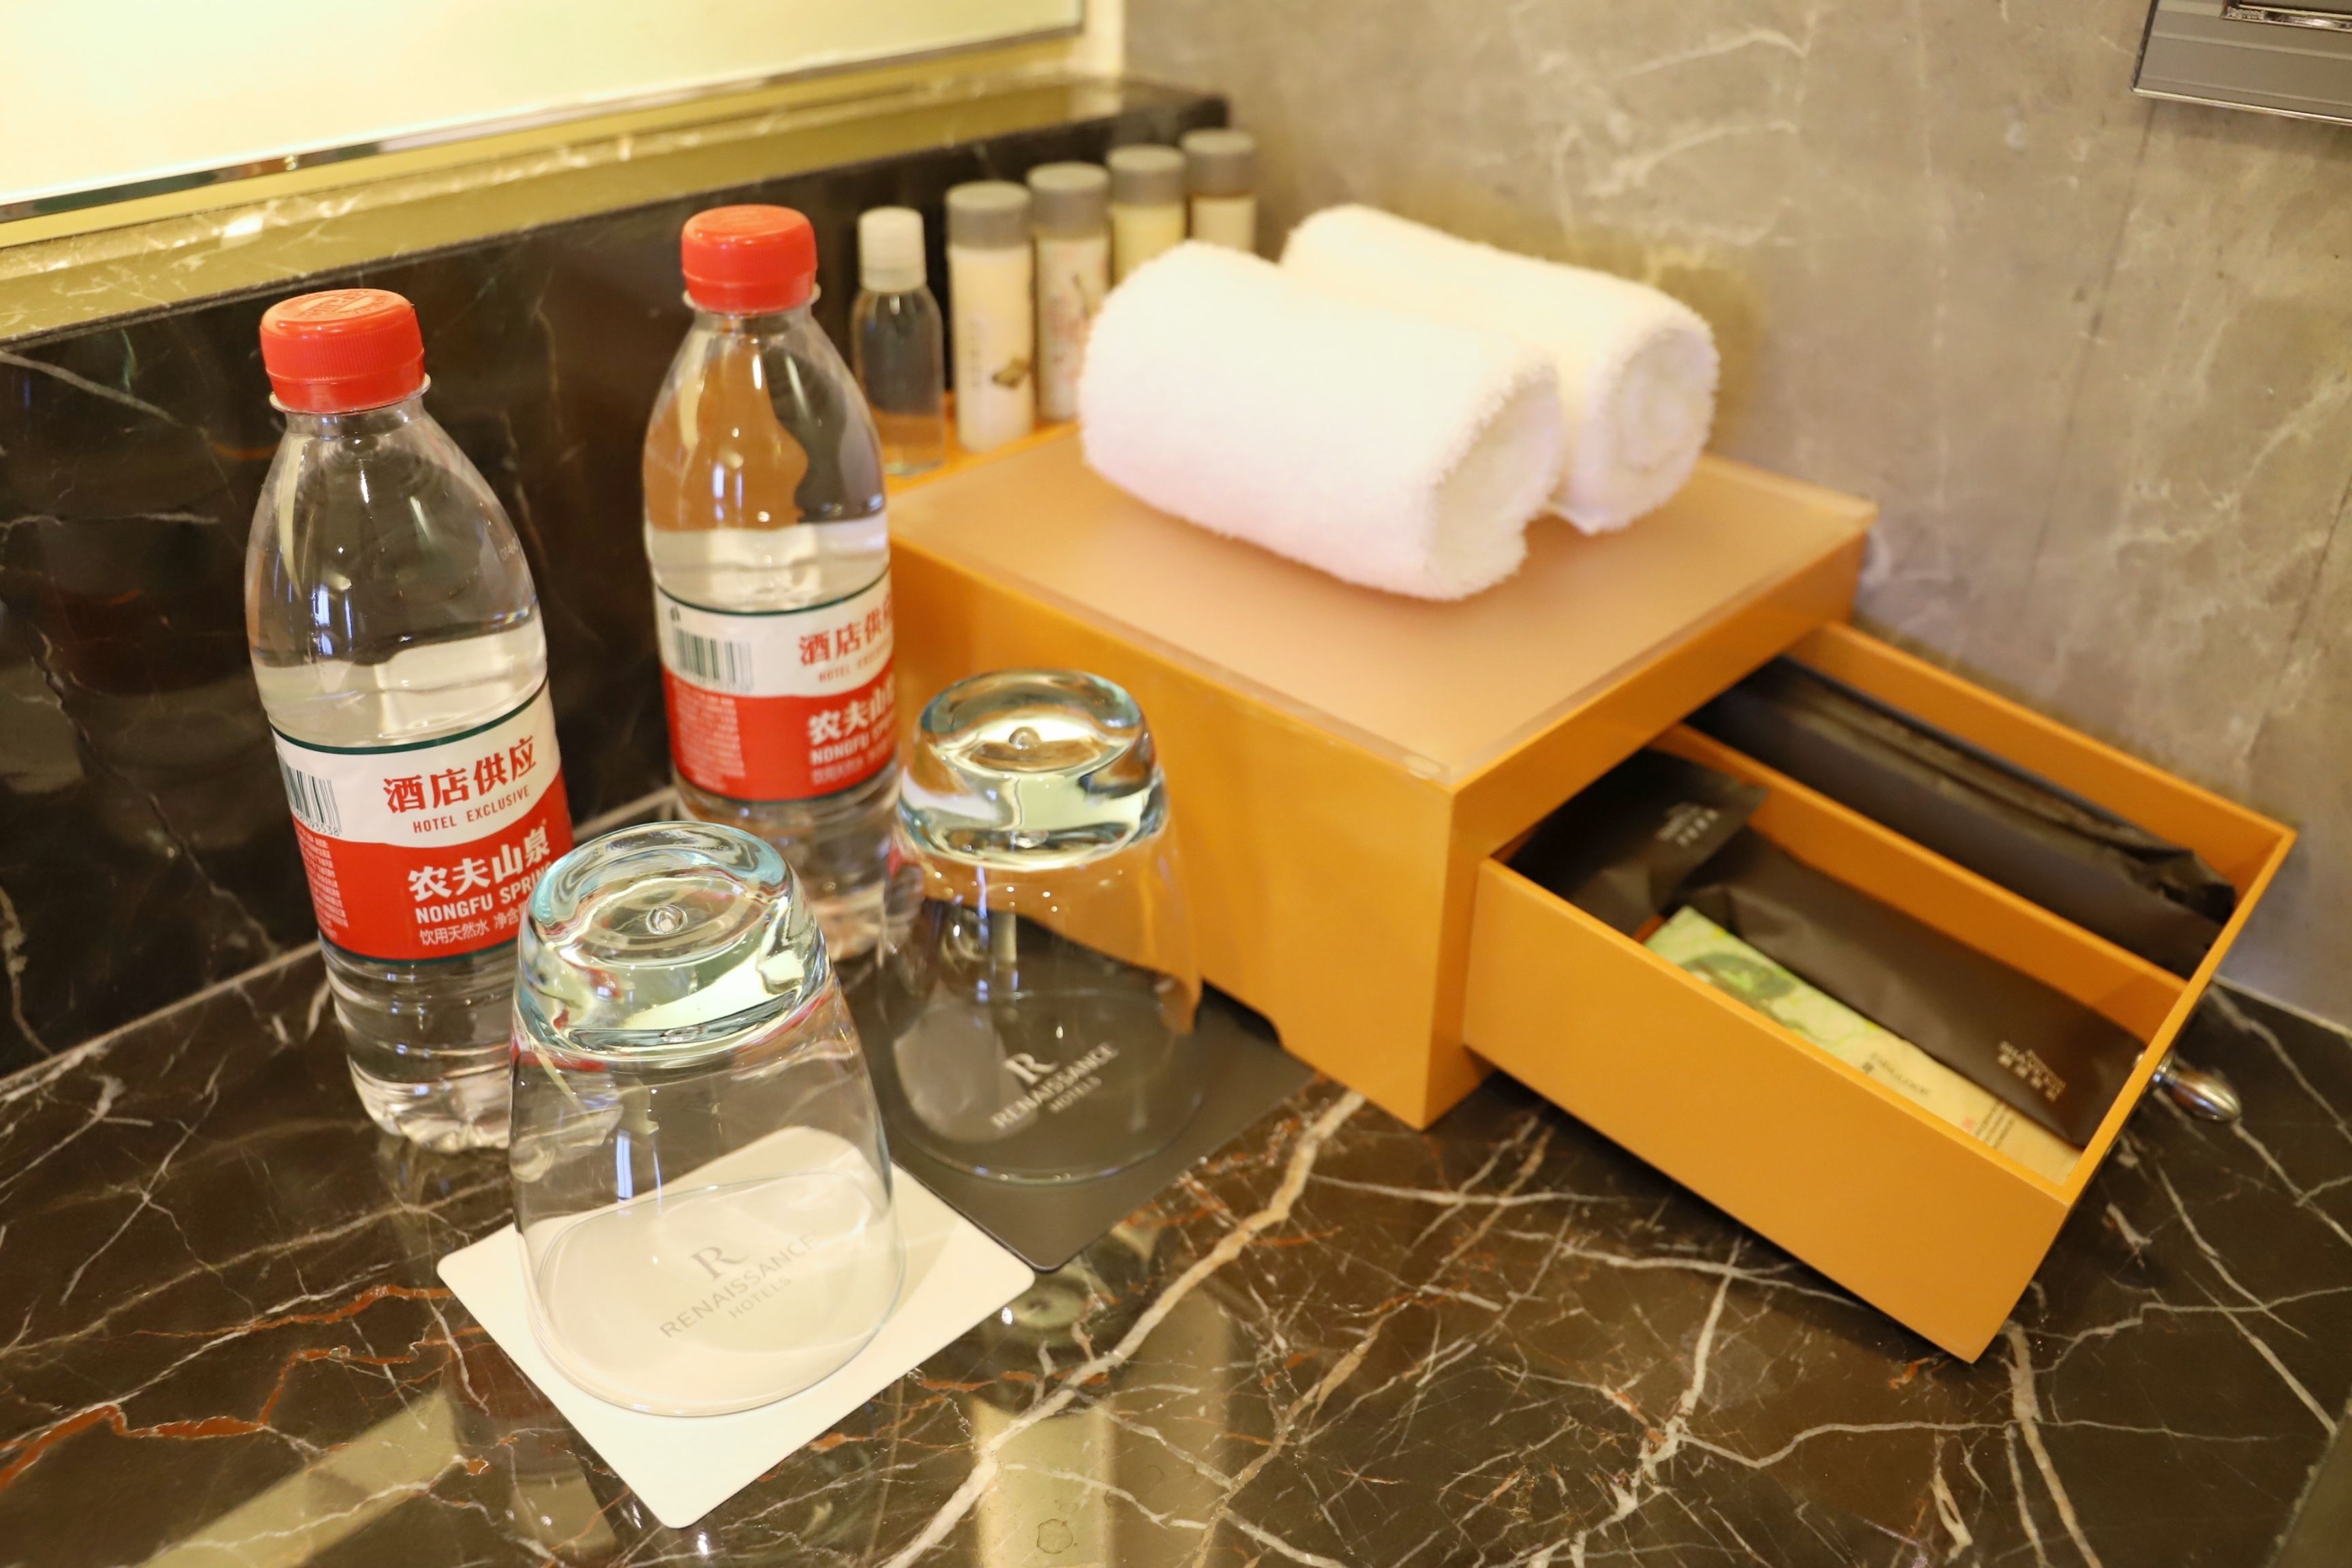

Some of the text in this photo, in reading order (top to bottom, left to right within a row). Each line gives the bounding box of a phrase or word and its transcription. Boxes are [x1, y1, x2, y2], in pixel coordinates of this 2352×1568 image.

[383, 734, 537, 814] 酒店供应
[413, 784, 530, 834] HOTEL EXCLUSIVE
[407, 819, 551, 902] 农夫山泉
[414, 892, 494, 924] NONGFU
[419, 918, 490, 946] 饮用天然水
[990, 1042, 1119, 1129] RENAISSANCE
[659, 1229, 817, 1338] RENAISSANCE
[689, 1246, 751, 1282] R
[727, 1275, 793, 1318] HOTELS
